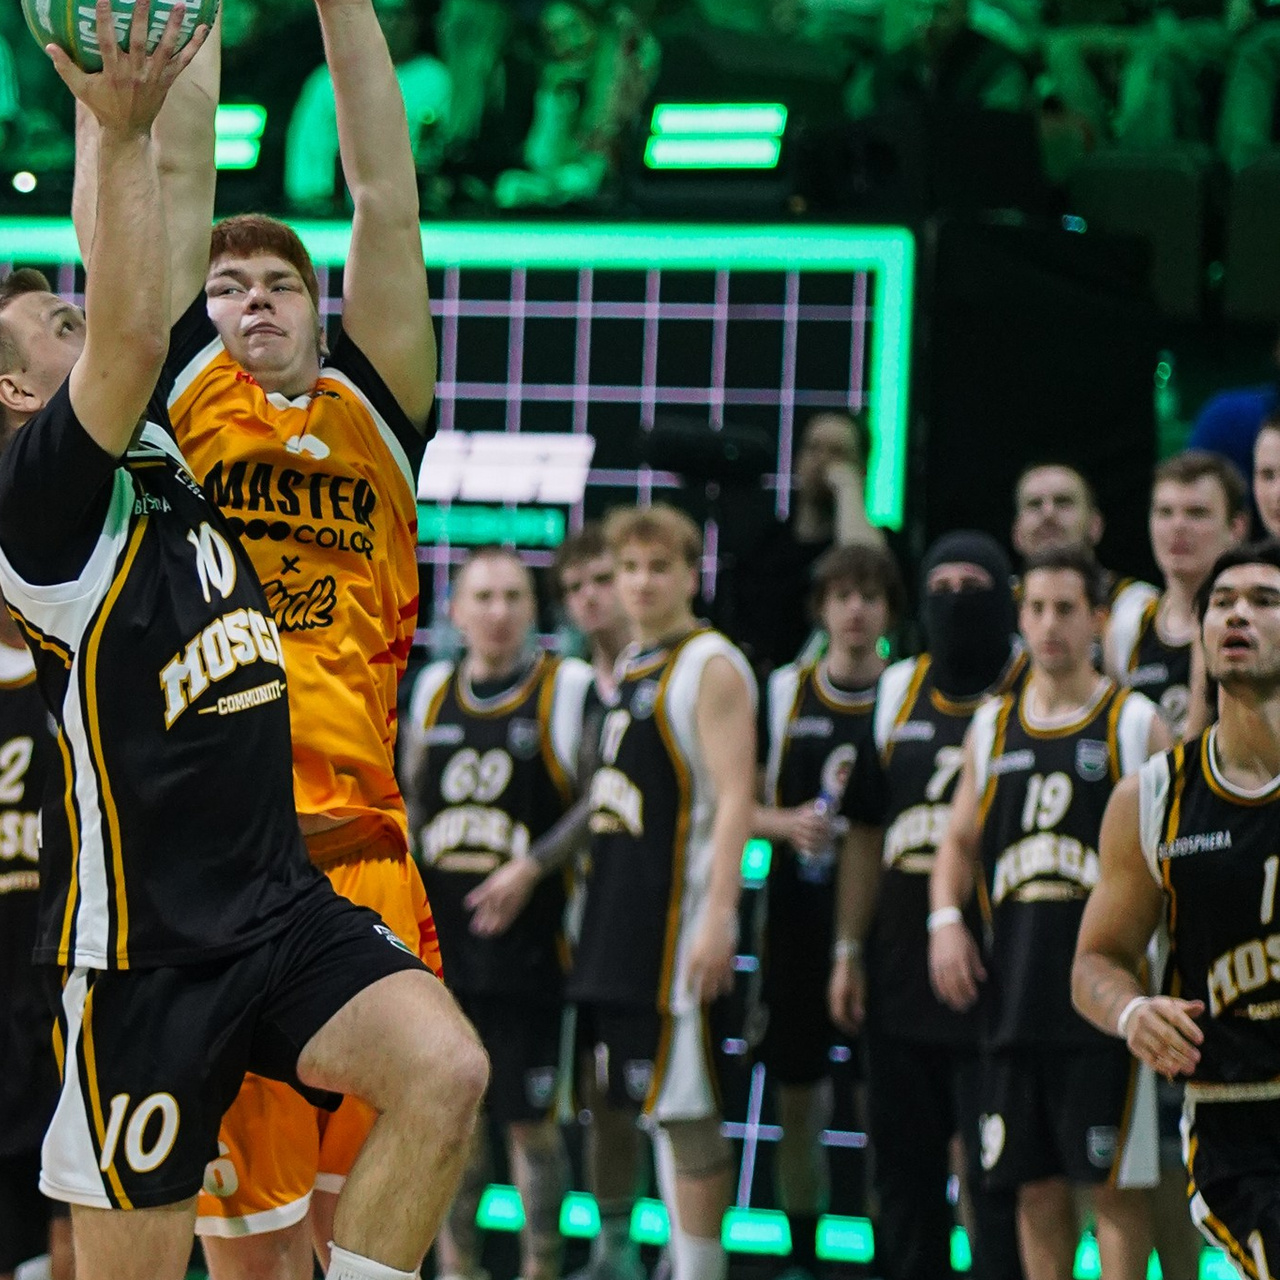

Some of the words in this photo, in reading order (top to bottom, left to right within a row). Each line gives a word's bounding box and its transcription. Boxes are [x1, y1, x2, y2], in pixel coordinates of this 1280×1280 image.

[204, 460, 376, 532] MASTER
[294, 524, 374, 561] COLOR
[440, 746, 514, 804] 69
[1022, 771, 1073, 832] 19
[100, 1092, 180, 1173] 10
